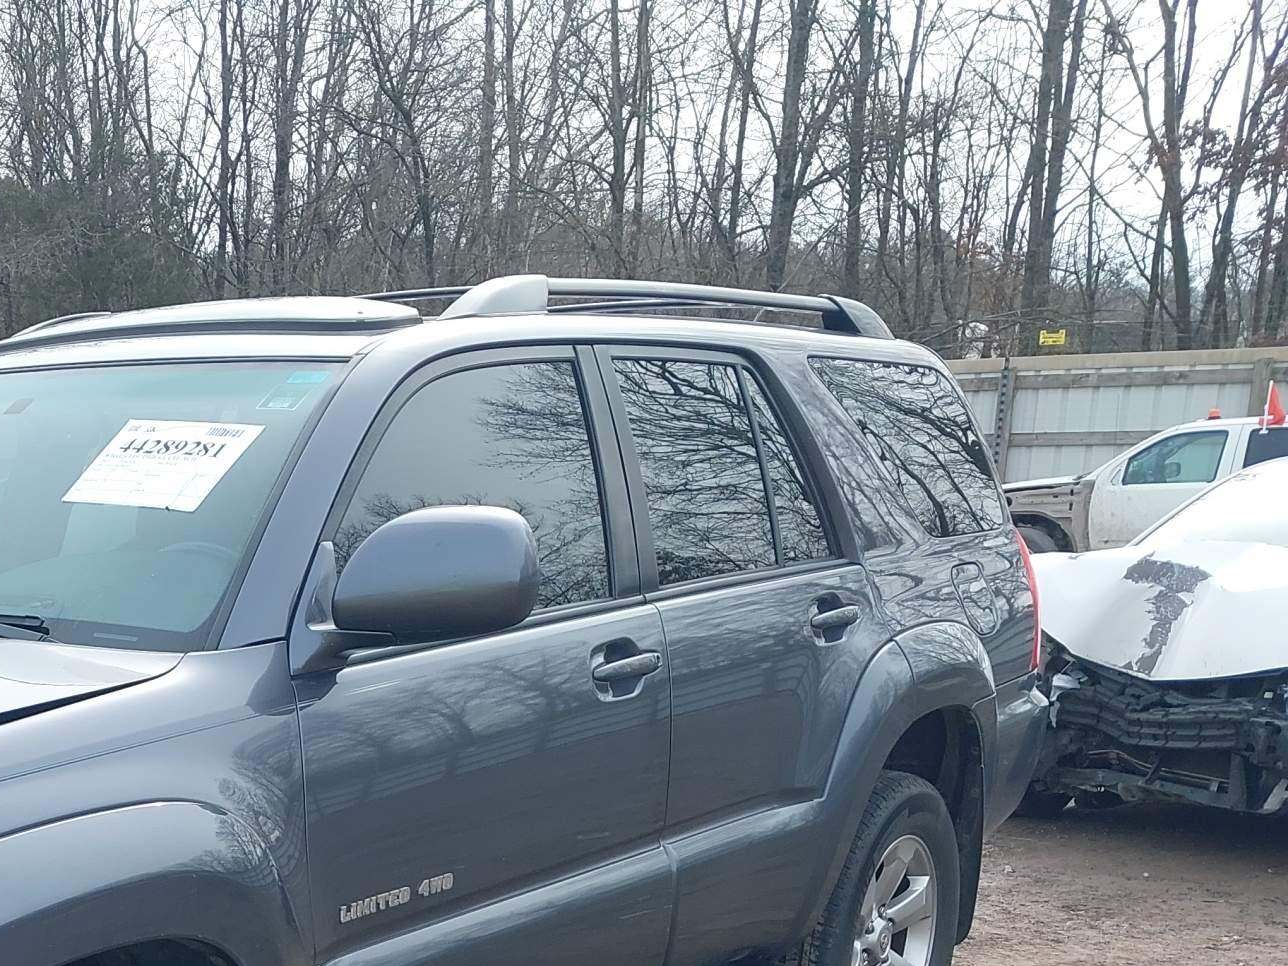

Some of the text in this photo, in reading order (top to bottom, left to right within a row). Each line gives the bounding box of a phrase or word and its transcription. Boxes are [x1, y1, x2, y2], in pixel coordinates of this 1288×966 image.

[119, 437, 228, 458] 44289281
[340, 872, 454, 924] LIMITED 4WD
